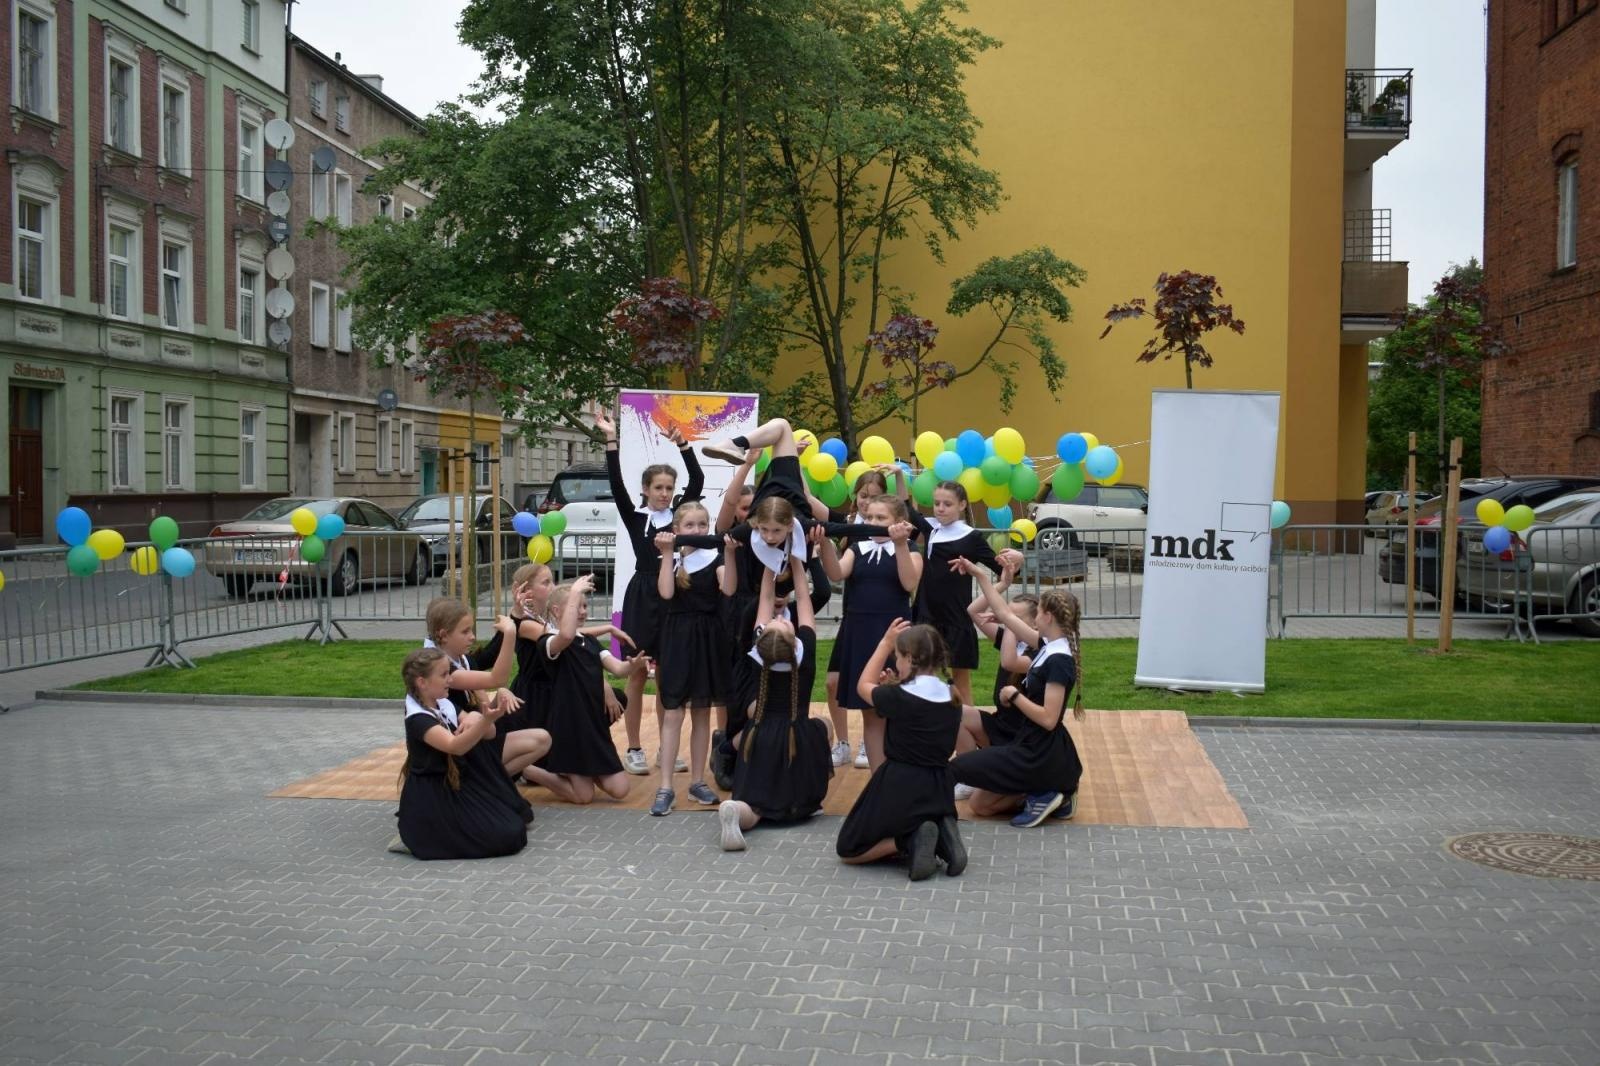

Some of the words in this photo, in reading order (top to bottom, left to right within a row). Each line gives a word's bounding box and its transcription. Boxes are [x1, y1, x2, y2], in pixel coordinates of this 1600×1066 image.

[1150, 529, 1234, 561] mdk
[1196, 561, 1212, 570] dom
[1213, 563, 1238, 573] kultury
